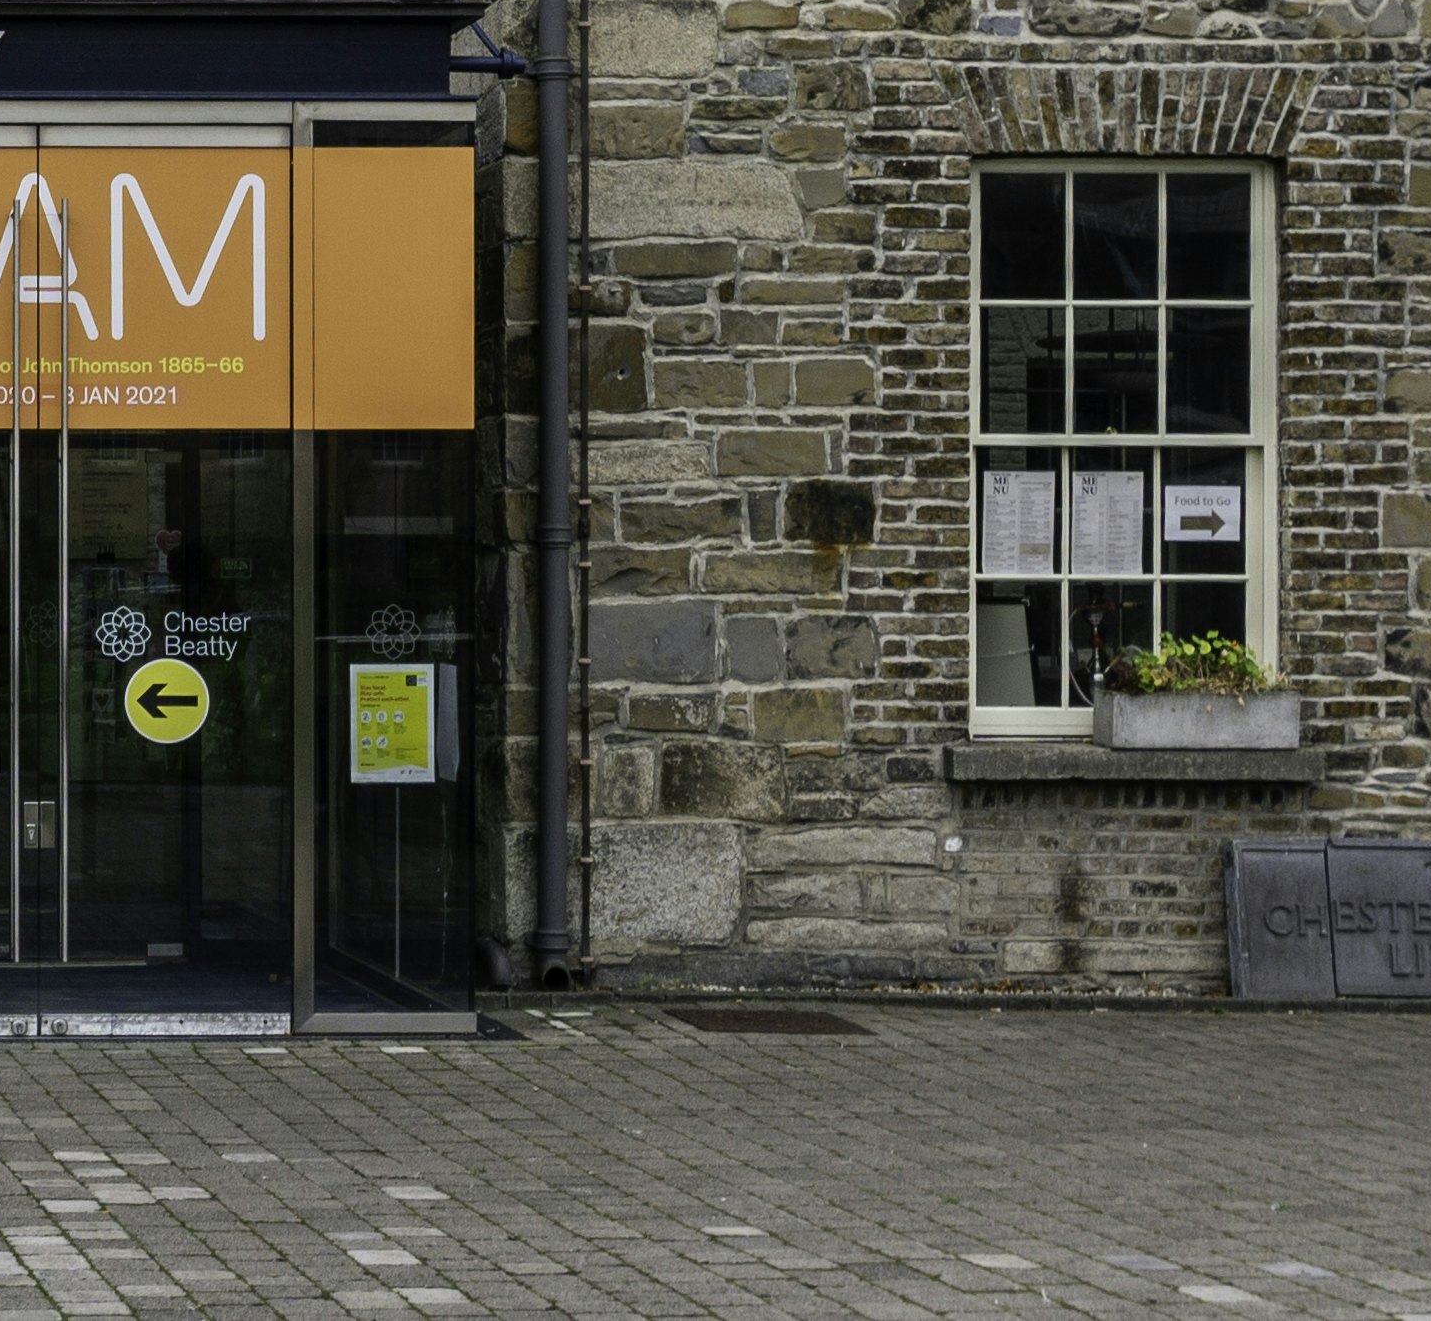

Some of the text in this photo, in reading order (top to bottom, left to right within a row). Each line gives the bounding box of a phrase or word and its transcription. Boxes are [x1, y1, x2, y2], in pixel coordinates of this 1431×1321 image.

[22, 357, 62, 374] John
[68, 357, 153, 374] Thomson
[80, 385, 120, 405] JAN
[125, 385, 179, 405] 2021
[1175, 495, 1231, 506] Food to Go
[164, 611, 252, 633] Chester
[165, 635, 238, 661] Beatty
